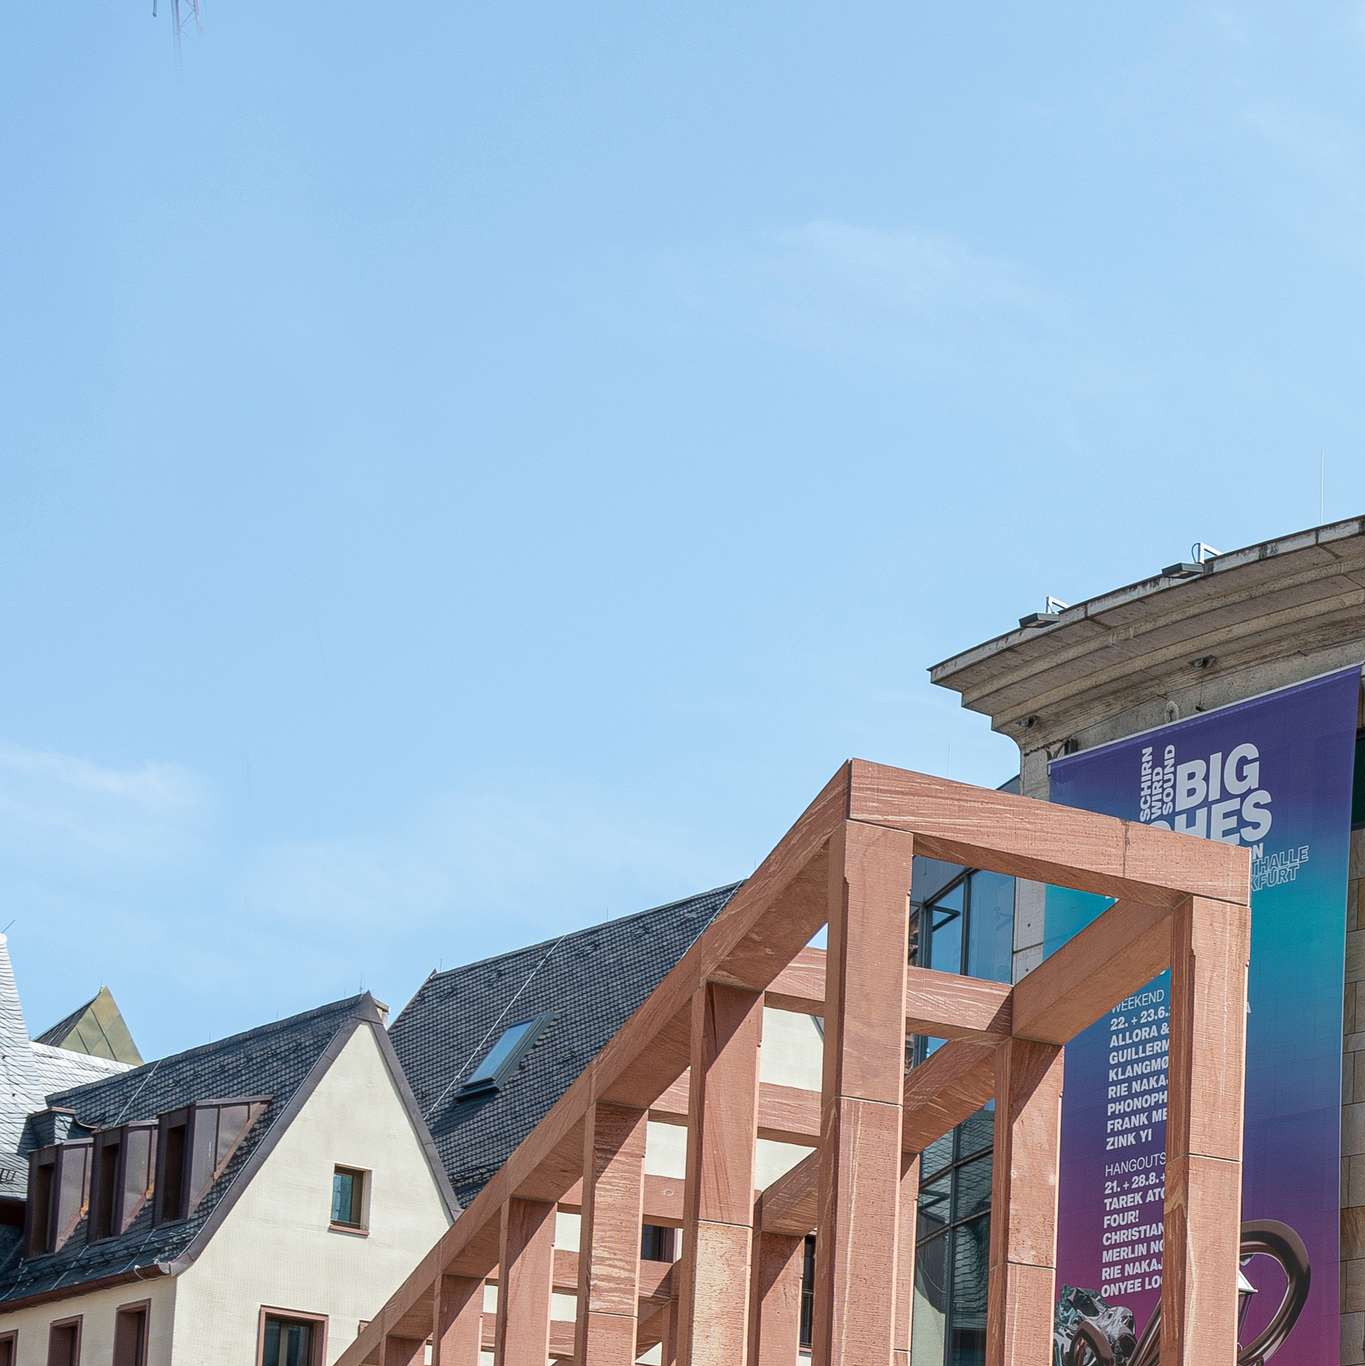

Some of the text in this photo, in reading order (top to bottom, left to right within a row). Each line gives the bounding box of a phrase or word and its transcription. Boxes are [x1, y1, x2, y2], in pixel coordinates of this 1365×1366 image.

[1140, 746, 1153, 822] SCHIRN
[1162, 744, 1176, 815] SOUND
[1175, 743, 1260, 812] BIG
[1151, 767, 1163, 820] WIRD
[1149, 790, 1272, 845] HES
[1111, 989, 1165, 1014] WEEKEND
[1109, 1022, 1170, 1048] ALLORA &
[1110, 1017, 1129, 1032] 22.
[1108, 1074, 1168, 1099] RIE NAKA
[1107, 1091, 1168, 1117] PHONOPH
[1106, 1111, 1150, 1134] FRANK
[1105, 1128, 1153, 1151] ZINK YI
[1105, 1151, 1166, 1177] HANGOUTS
[1104, 1181, 1121, 1195] 21.
[1131, 1172, 1159, 1189] 28.8.
[1104, 1191, 1144, 1212] TAREK
[1103, 1209, 1140, 1228] FOUR!
[1102, 1242, 1147, 1264] MERLIN
[1101, 1264, 1121, 1281] RIE
[1101, 1274, 1163, 1298] ONYEE LO
